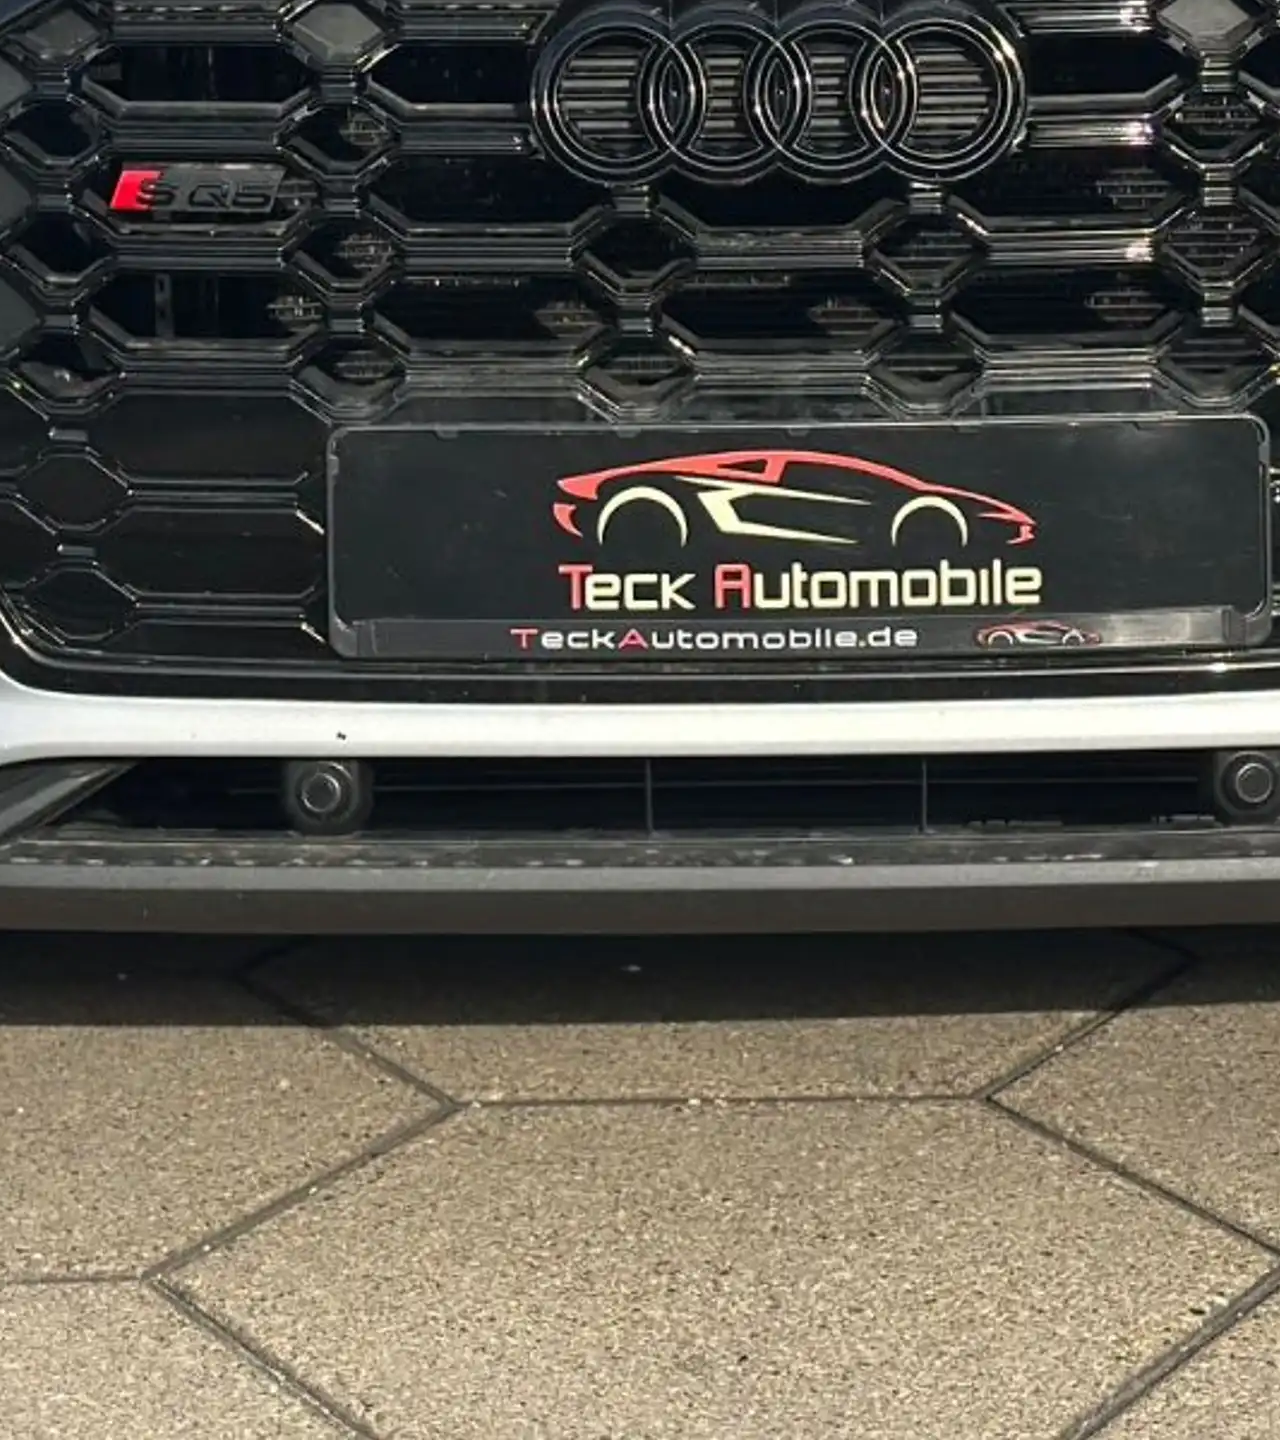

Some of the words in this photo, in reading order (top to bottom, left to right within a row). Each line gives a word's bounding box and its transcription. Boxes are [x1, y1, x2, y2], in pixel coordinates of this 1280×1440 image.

[558, 564, 696, 610] Teck
[713, 559, 1041, 609] Automobile
[511, 626, 917, 650] TeckAutomobile.de
